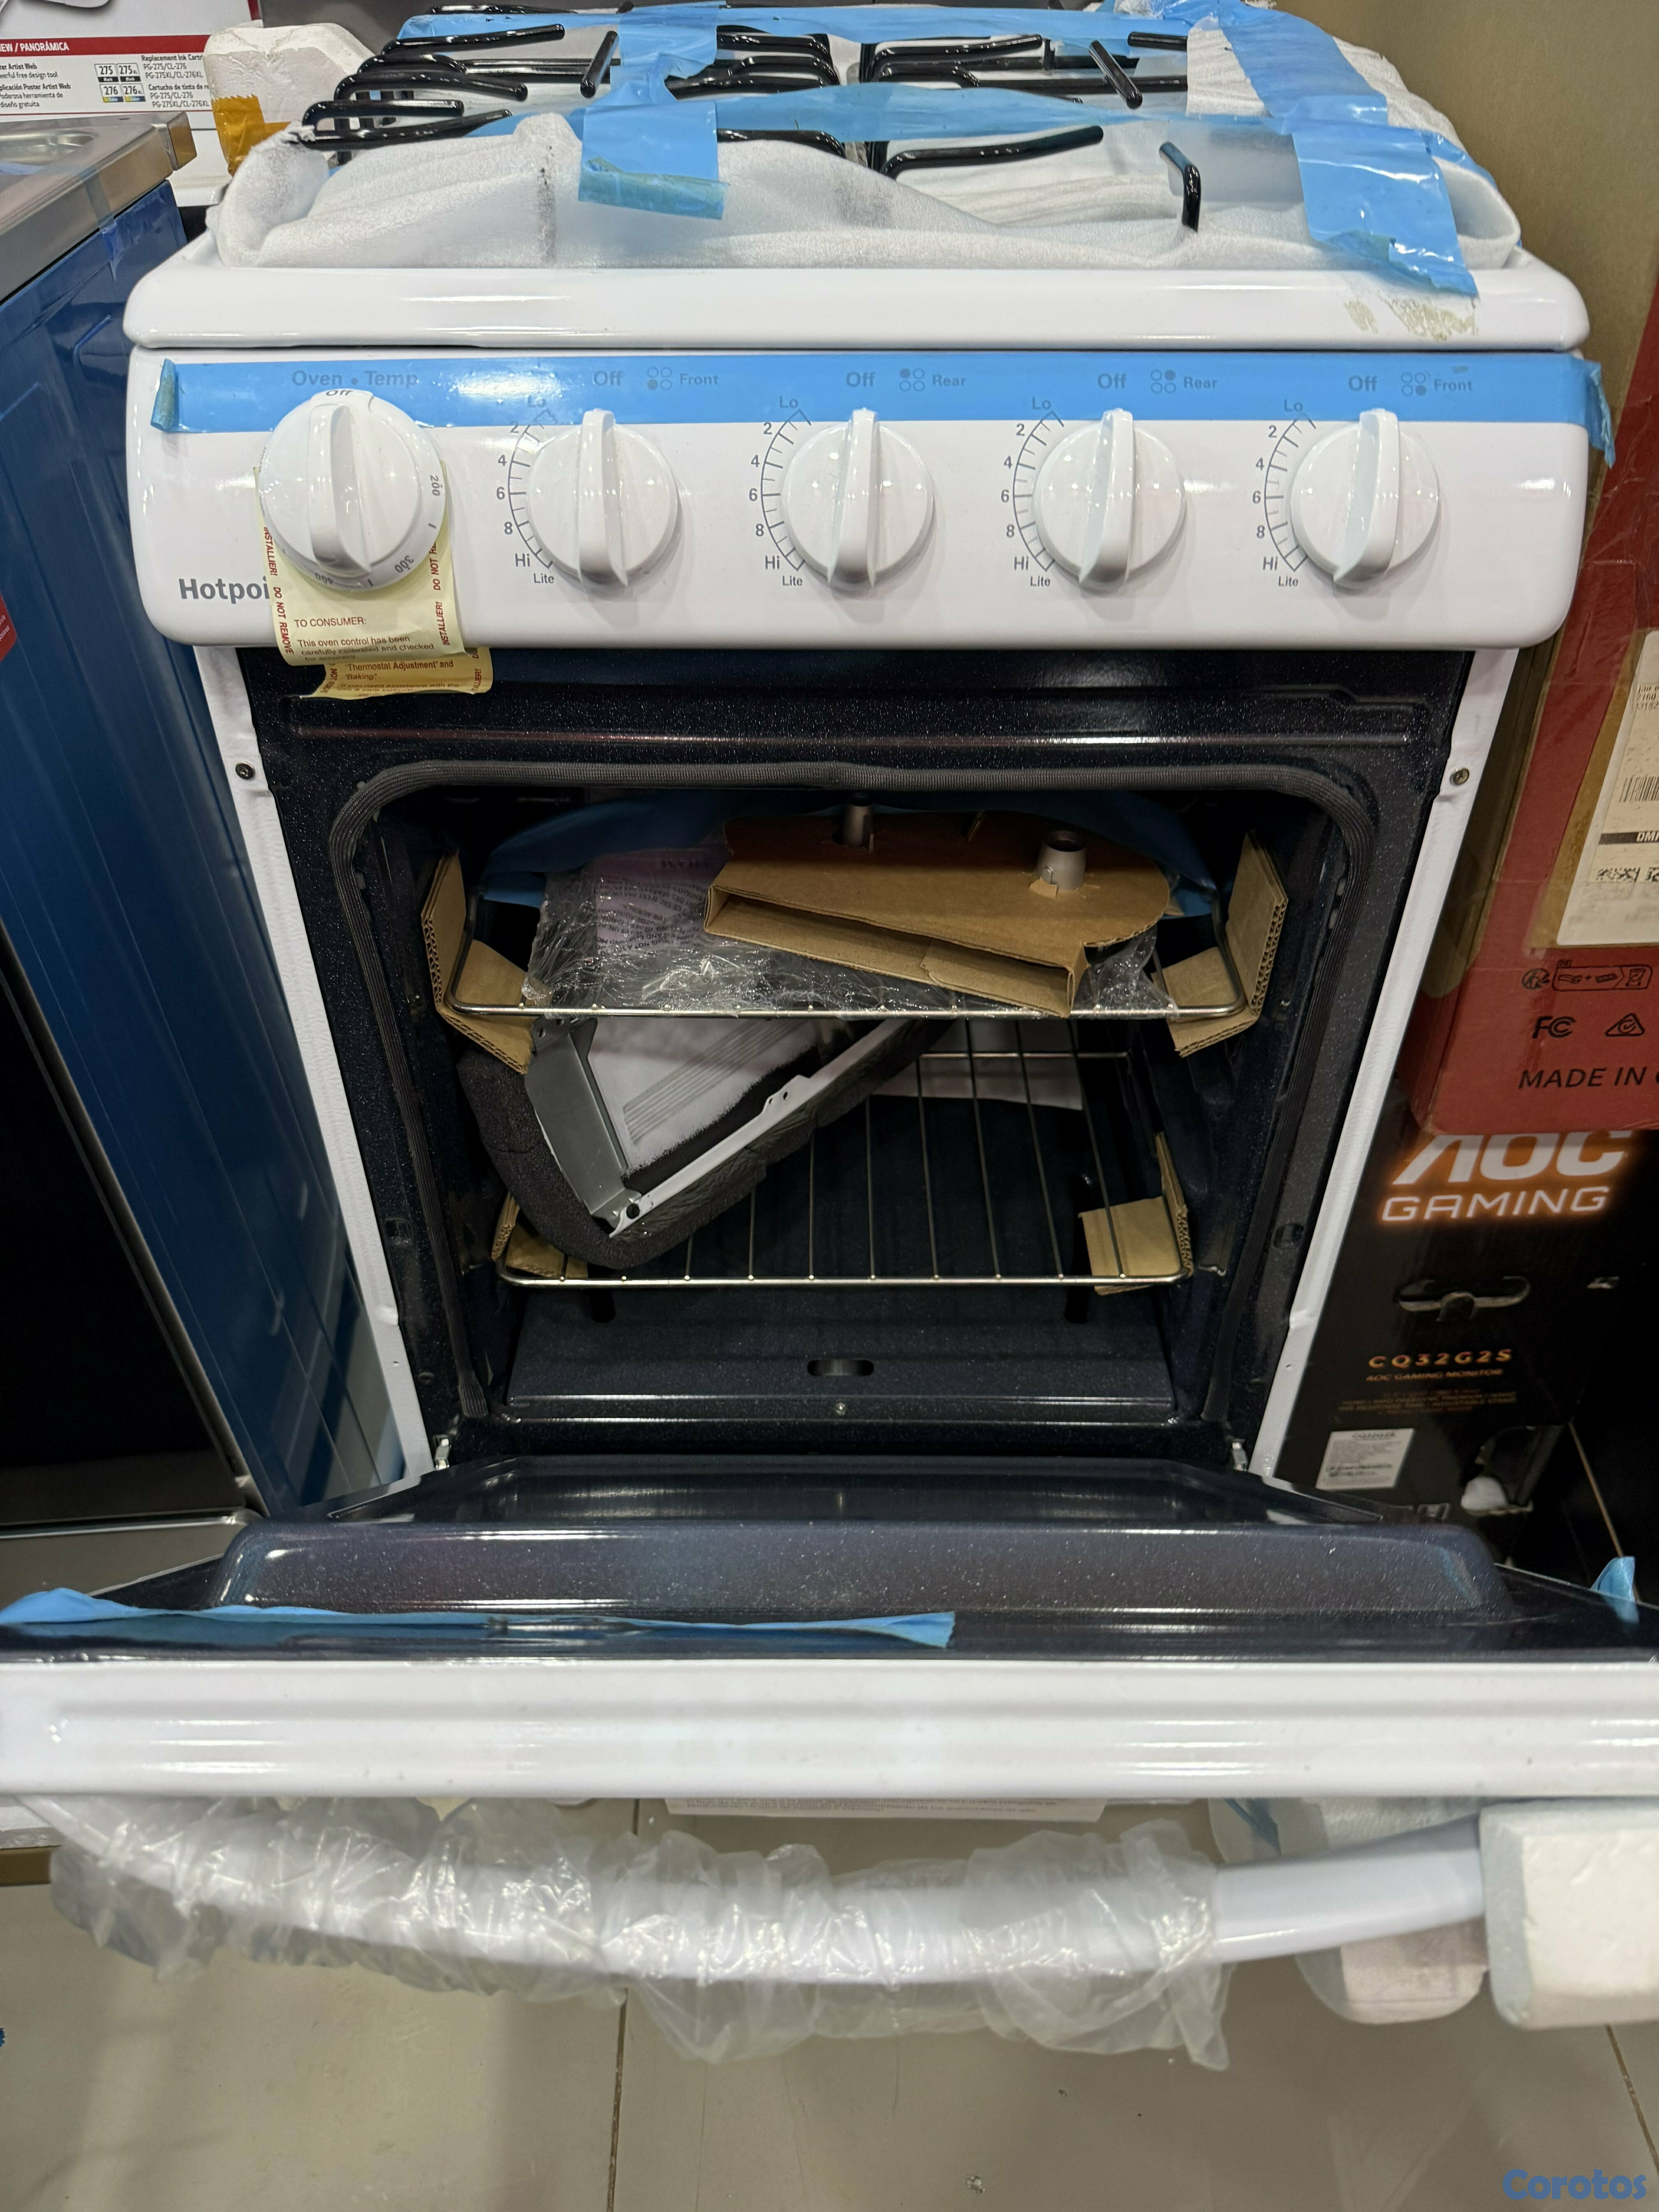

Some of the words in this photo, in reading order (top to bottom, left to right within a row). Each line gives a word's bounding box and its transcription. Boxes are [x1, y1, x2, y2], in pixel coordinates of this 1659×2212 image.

[20, 41, 70, 52] PANORÁMICA
[28, 72, 46, 80] design
[99, 66, 113, 75] 275
[104, 86, 118, 95] 276
[292, 370, 342, 386] Oven
[365, 370, 419, 389] Temp
[593, 371, 622, 387] Off
[680, 373, 719, 386] Front
[846, 371, 875, 387] Off
[932, 375, 966, 387] Rear
[1098, 373, 1127, 390] Off
[1184, 376, 1217, 389] Rear
[1349, 375, 1378, 393] Off
[1434, 378, 1473, 392] Front
[528, 395, 546, 408] Lo
[780, 396, 798, 408] Lo
[1032, 397, 1051, 410] Lo
[1284, 399, 1303, 412] Lo
[510, 421, 519, 433] 2
[763, 422, 772, 435] 2
[1016, 423, 1025, 436] 2
[1268, 425, 1277, 438] 2
[497, 454, 507, 466] 4
[751, 455, 760, 467] 4
[1004, 456, 1012, 469] 4
[1255, 458, 1264, 470] 4
[430, 476, 440, 496] 200
[496, 486, 505, 500] 6
[749, 488, 758, 501] 6
[1001, 489, 1009, 502] 6
[1252, 491, 1261, 504] 6
[504, 521, 513, 534] 8
[755, 523, 764, 537] 8
[1006, 524, 1015, 538] 8
[1256, 525, 1265, 539] 8
[394, 555, 414, 573] 300
[430, 558, 439, 575] NOT
[515, 553, 530, 567] Hi
[765, 555, 780, 569] Hi
[1014, 556, 1029, 570] Hi
[1263, 556, 1277, 571] Hi
[434, 579, 441, 591] DO
[533, 573, 554, 584] Lite
[782, 576, 803, 586] Lite
[1030, 576, 1050, 587] Lite
[1278, 576, 1298, 587] Lite
[178, 576, 270, 604] Hotpoi
[273, 587, 282, 598] DO
[276, 602, 286, 619] NOT
[294, 619, 308, 628] TO
[310, 617, 367, 627] CONSUMER:
[434, 602, 451, 646] INSTALLIER!
[279, 622, 294, 654] REMOVE
[297, 639, 316, 648] This
[341, 637, 369, 646] control
[371, 636, 386, 645] has
[301, 648, 336, 656] carefully
[393, 660, 439, 670] Adjustment"
[1518, 1068, 1607, 1090] MADE
[1614, 1067, 1647, 1086] IN
[1392, 1130, 1634, 1185] AOC
[1382, 1186, 1610, 1222] GAMING
[1394, 1371, 1444, 1381] GAMING
[1446, 1368, 1504, 1378] MONITOR
